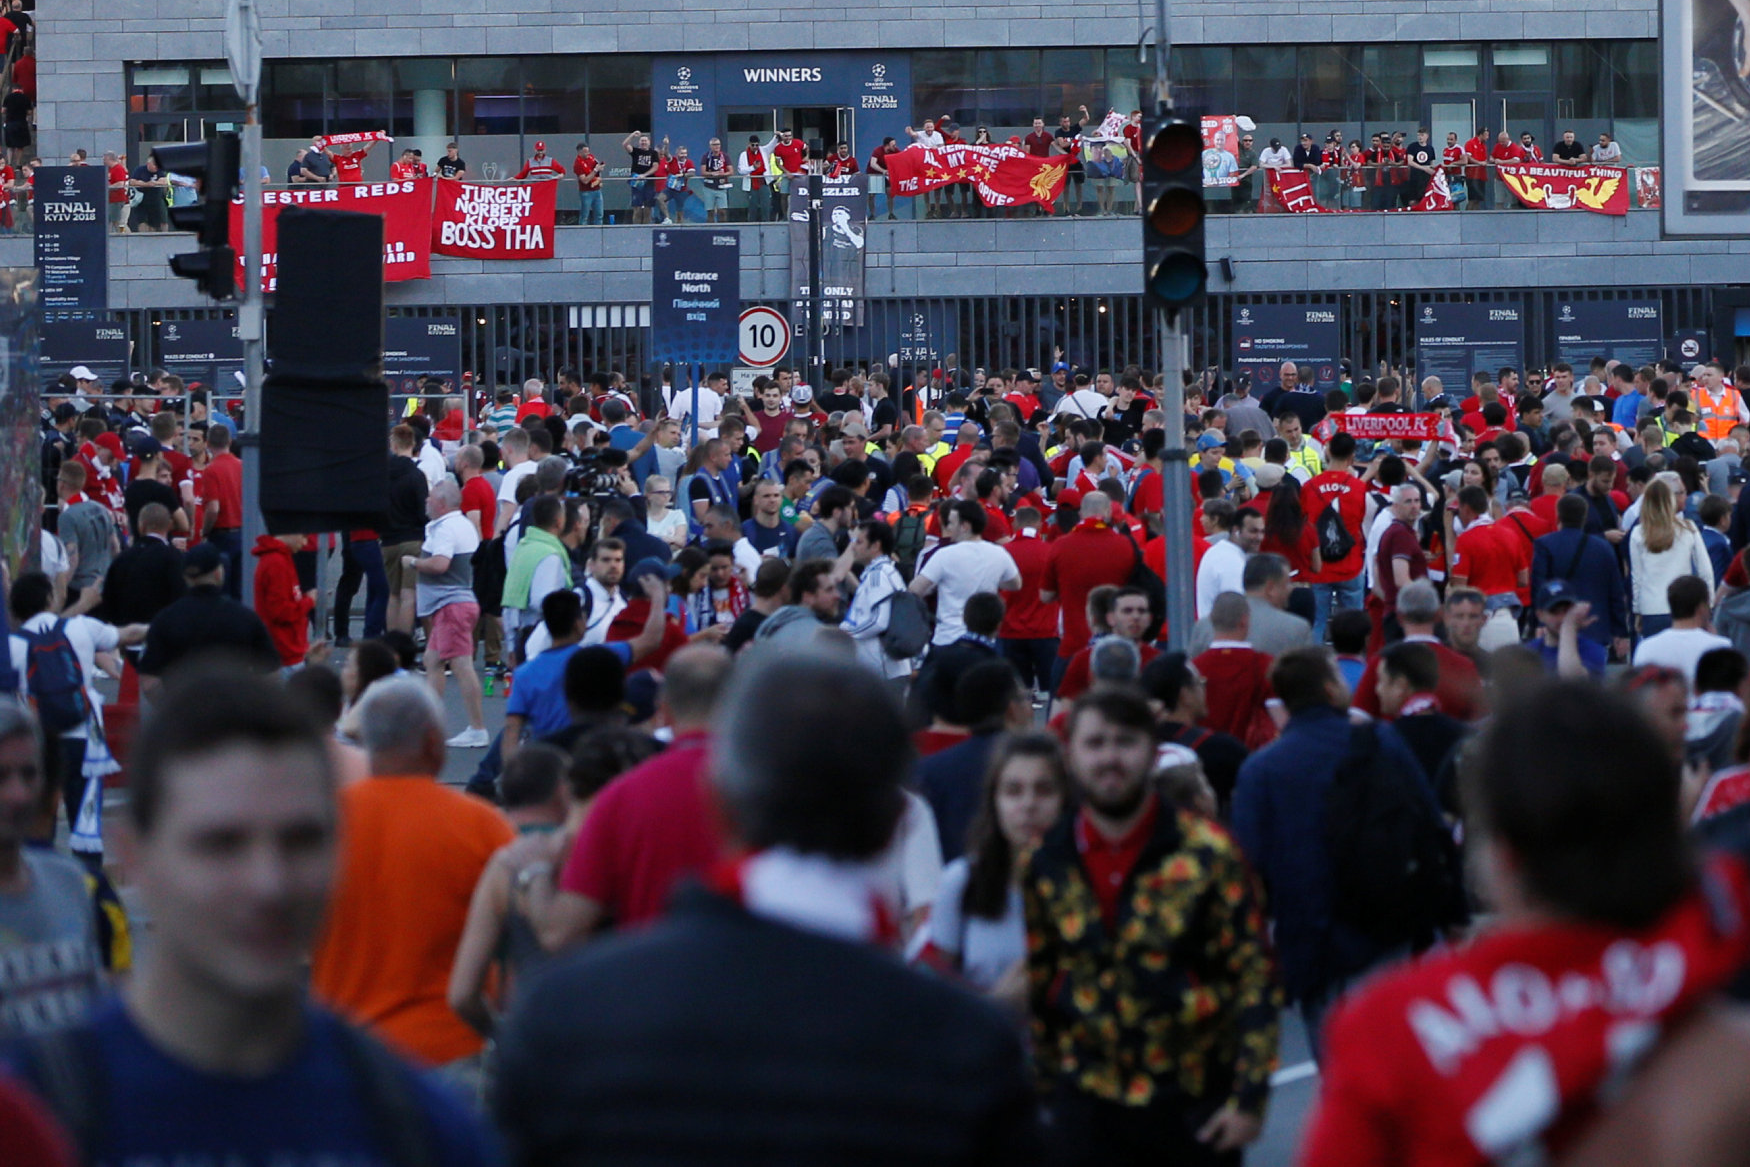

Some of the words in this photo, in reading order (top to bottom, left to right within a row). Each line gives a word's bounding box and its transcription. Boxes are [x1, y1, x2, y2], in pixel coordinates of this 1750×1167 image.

[744, 67, 822, 82] WINNERS
[666, 98, 703, 107] FINAL
[862, 95, 898, 103] FINAL
[948, 151, 966, 168] MY
[1518, 166, 1527, 175] A
[1530, 166, 1587, 177] BEAUTIFUL
[1589, 168, 1622, 178] THING
[354, 182, 414, 198] REDS
[899, 176, 918, 192] THE
[44, 202, 96, 213] FINAL
[455, 199, 533, 217] NORBERT
[44, 213, 70, 221] KYIV
[72, 213, 96, 221] 2018
[466, 215, 519, 227] KLOPP
[441, 220, 495, 250] BOSS
[502, 224, 544, 250] THA
[674, 271, 718, 281] Entrance
[682, 283, 711, 293] North
[824, 287, 853, 296] ONLY
[673, 298, 720, 309] Північний
[686, 311, 706, 322] вхід
[748, 324, 776, 348] 10
[1345, 417, 1411, 430] LIVERPOOL
[1414, 417, 1428, 430] FC
